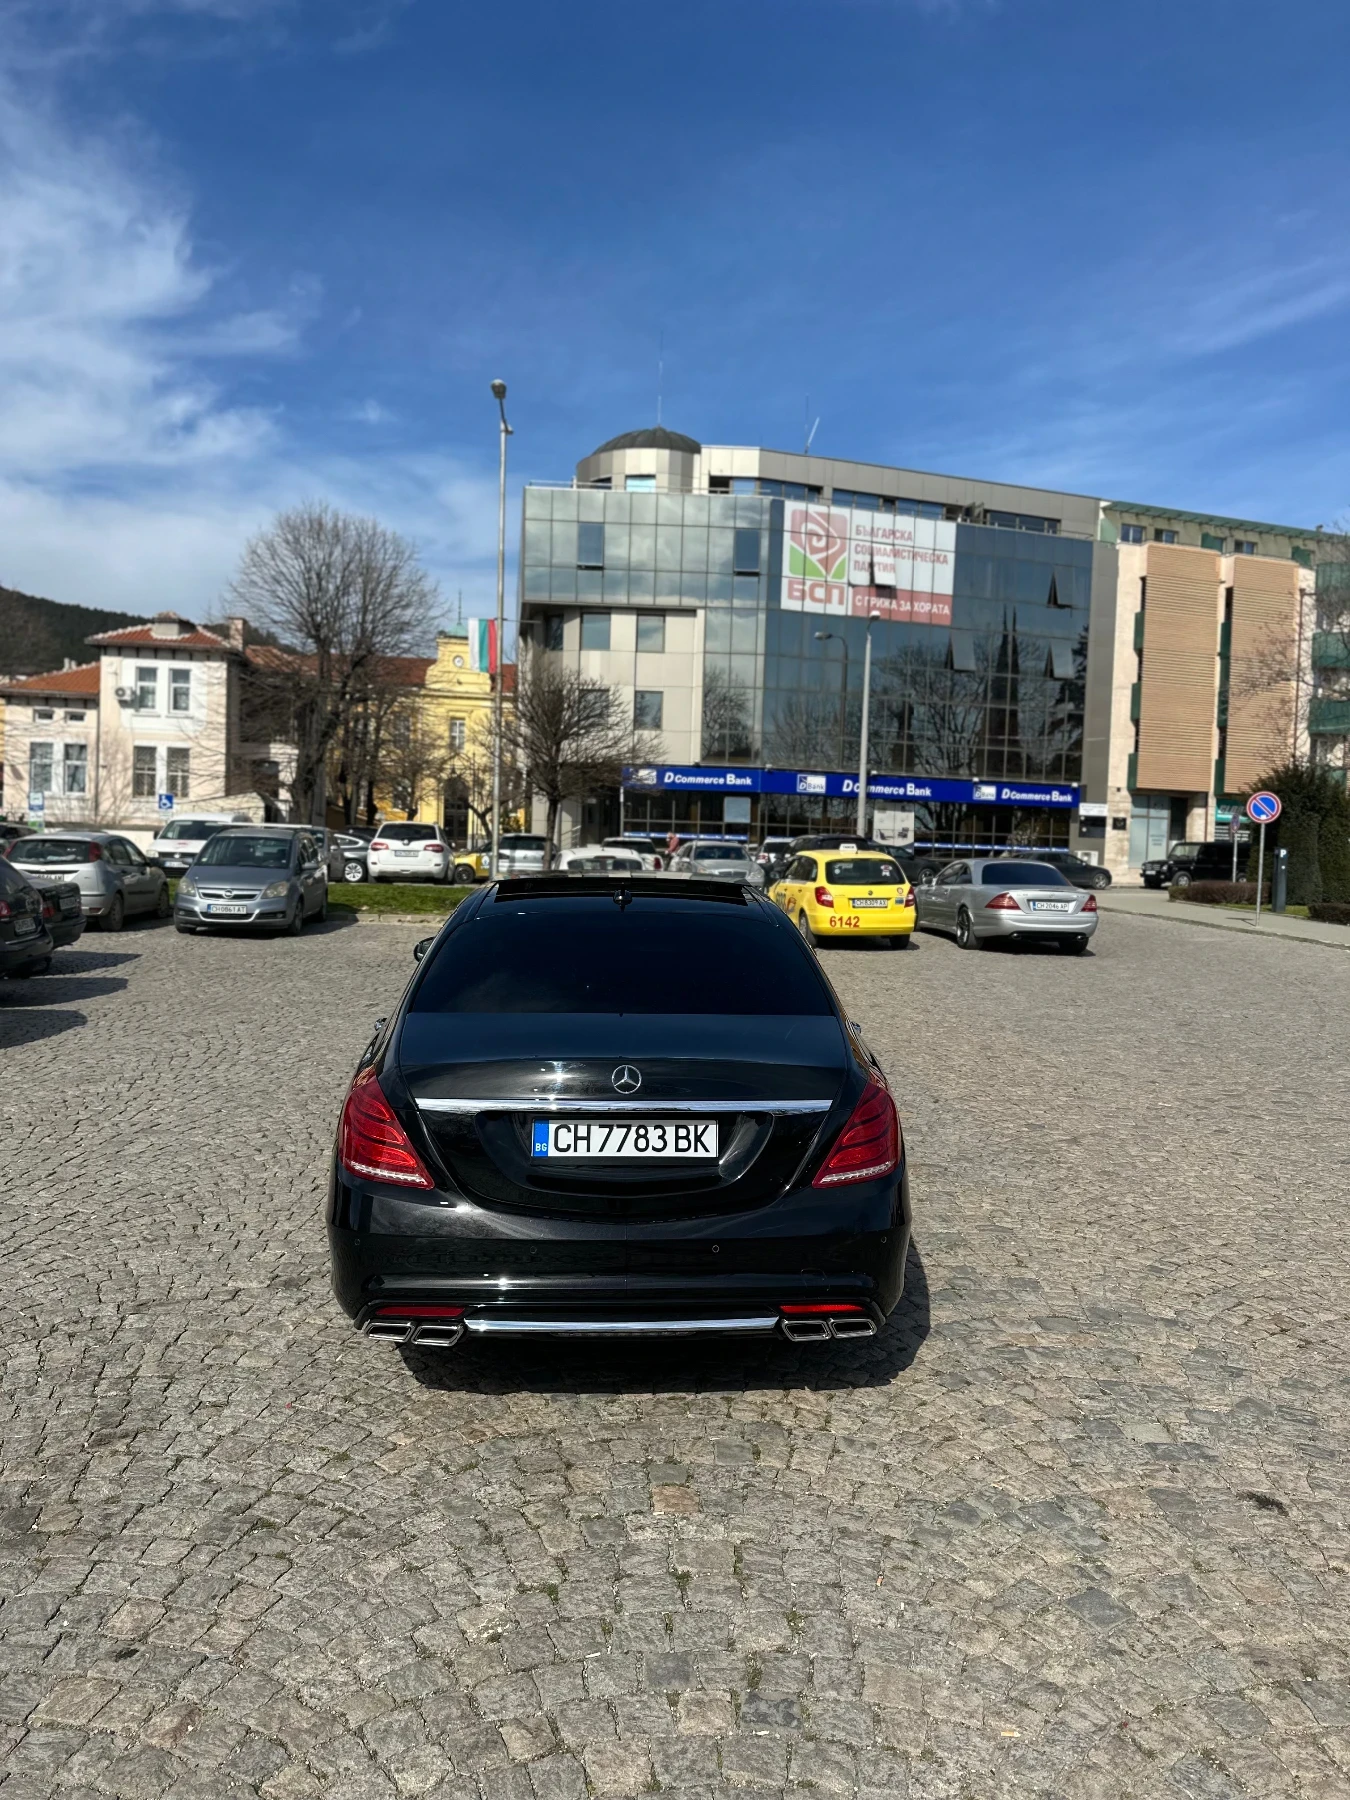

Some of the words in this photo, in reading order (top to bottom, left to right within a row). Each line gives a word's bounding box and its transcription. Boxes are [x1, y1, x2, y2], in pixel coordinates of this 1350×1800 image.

[856, 525, 913, 541] БЪЛГАРСКА
[854, 544, 949, 565] СОЦИАЛИСТИЧЕСКА
[788, 578, 845, 606] БСП
[855, 595, 863, 606] С
[864, 597, 898, 610] ГРИЖА
[900, 601, 911, 611] ЗА
[913, 601, 950, 615] ХОРАТА
[726, 773, 752, 786] Bank
[853, 782, 905, 795] Cmmerce
[906, 782, 932, 797] Bank
[1051, 791, 1073, 802] Bank
[829, 915, 861, 928] 6142
[535, 1143, 548, 1152] BG
